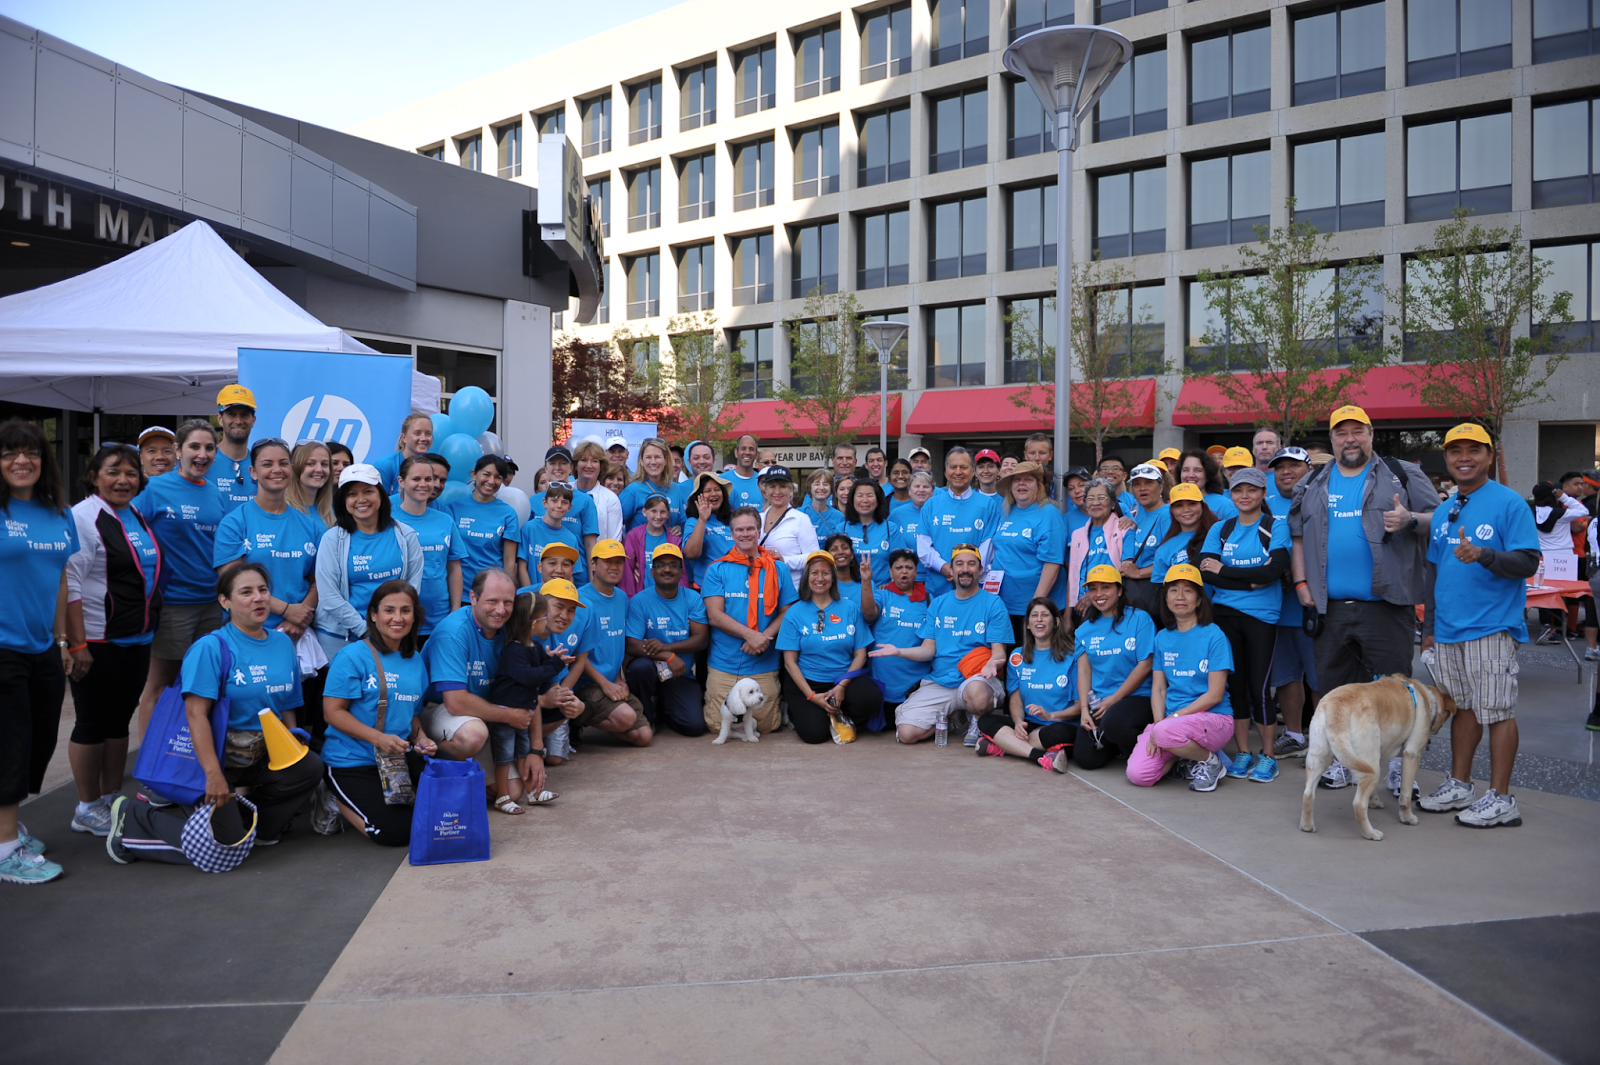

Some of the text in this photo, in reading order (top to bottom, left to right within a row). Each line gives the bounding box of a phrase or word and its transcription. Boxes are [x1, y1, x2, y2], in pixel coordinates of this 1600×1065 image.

[605, 429, 623, 437] HPCIA
[774, 452, 794, 462] YEAR
[796, 452, 807, 461] UP
[809, 452, 825, 461] BAY
[180, 504, 200, 512] Kidney
[1334, 510, 1354, 518] Team
[5, 520, 28, 528] Kidney
[194, 522, 212, 532] Team
[8, 530, 27, 538] 2014
[467, 530, 484, 538] Team
[27, 540, 66, 550] Team HP
[436, 544, 444, 552] HP
[270, 550, 290, 558] Team
[352, 554, 372, 562] Kidney
[368, 567, 402, 580] Team HP
[897, 620, 913, 628] Team
[248, 664, 268, 672] Kidney
[252, 676, 267, 684] 2014
[266, 684, 284, 694] Team
[394, 692, 412, 702] Team
[176, 734, 188, 742] Your
[168, 738, 186, 748] Kidney
[172, 744, 192, 754] Partner
